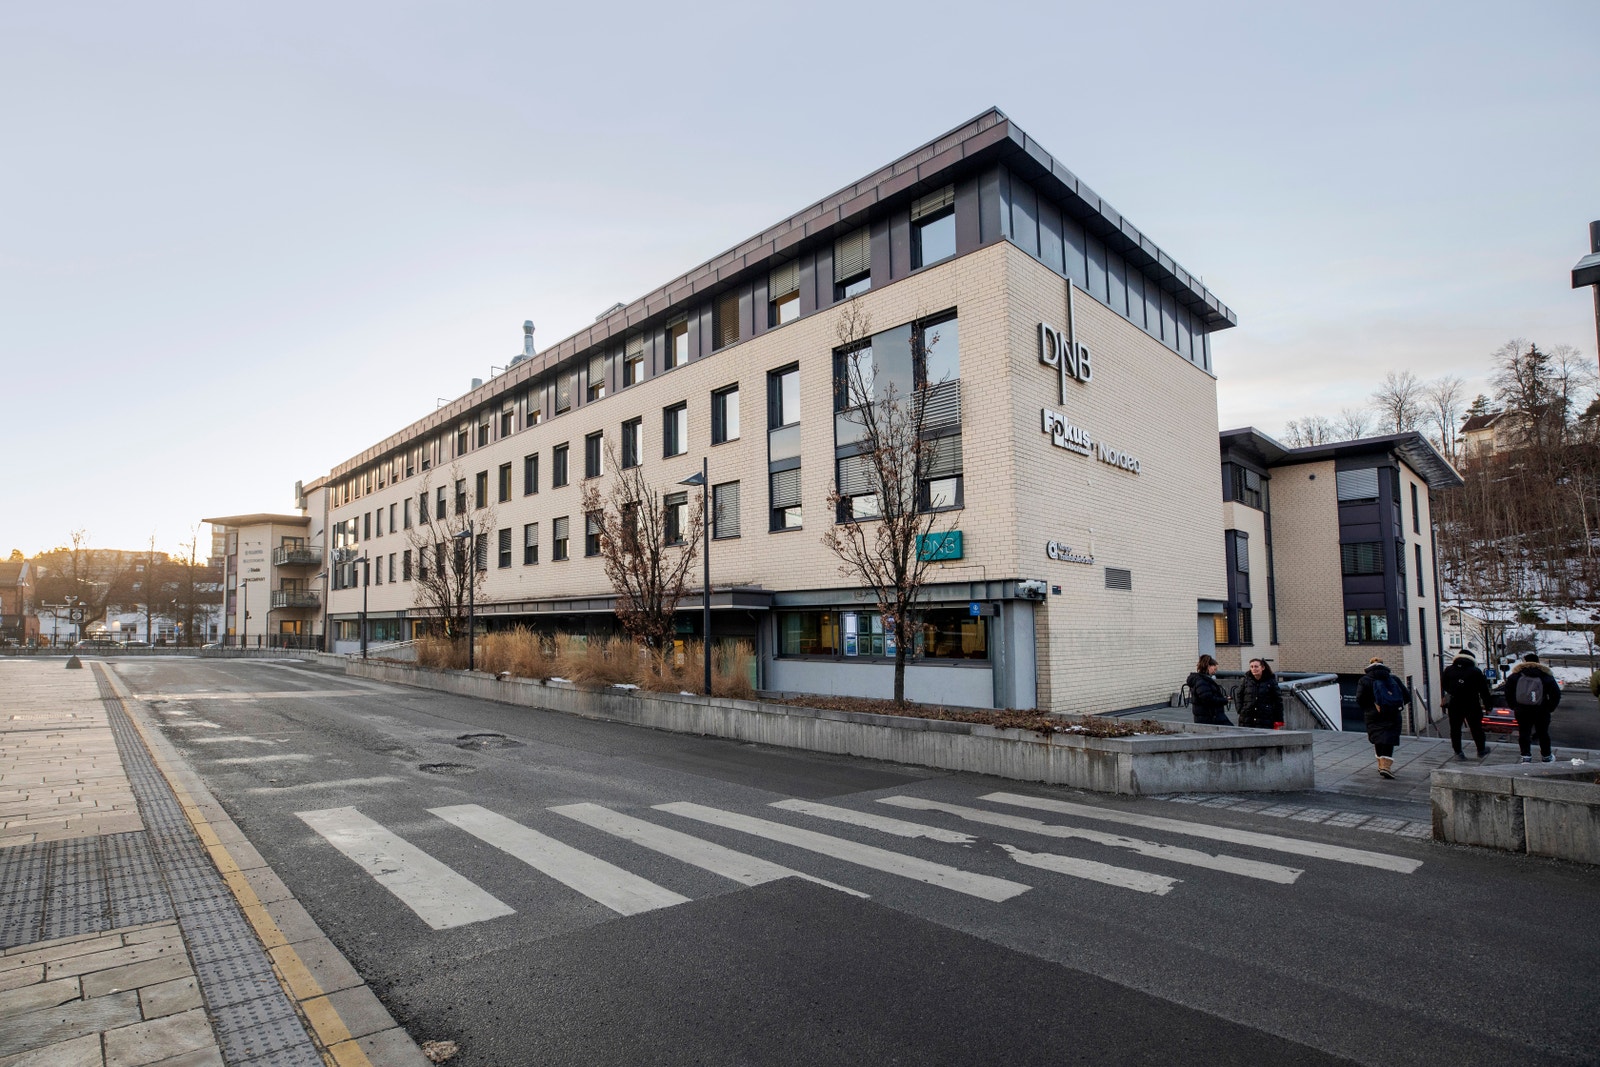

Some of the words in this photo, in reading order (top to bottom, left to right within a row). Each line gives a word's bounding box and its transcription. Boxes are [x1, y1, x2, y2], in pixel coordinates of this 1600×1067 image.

[1037, 279, 1093, 405] DNB
[1041, 408, 1091, 449] Fokus
[1097, 442, 1142, 475] Nordea
[921, 537, 955, 560] DNB
